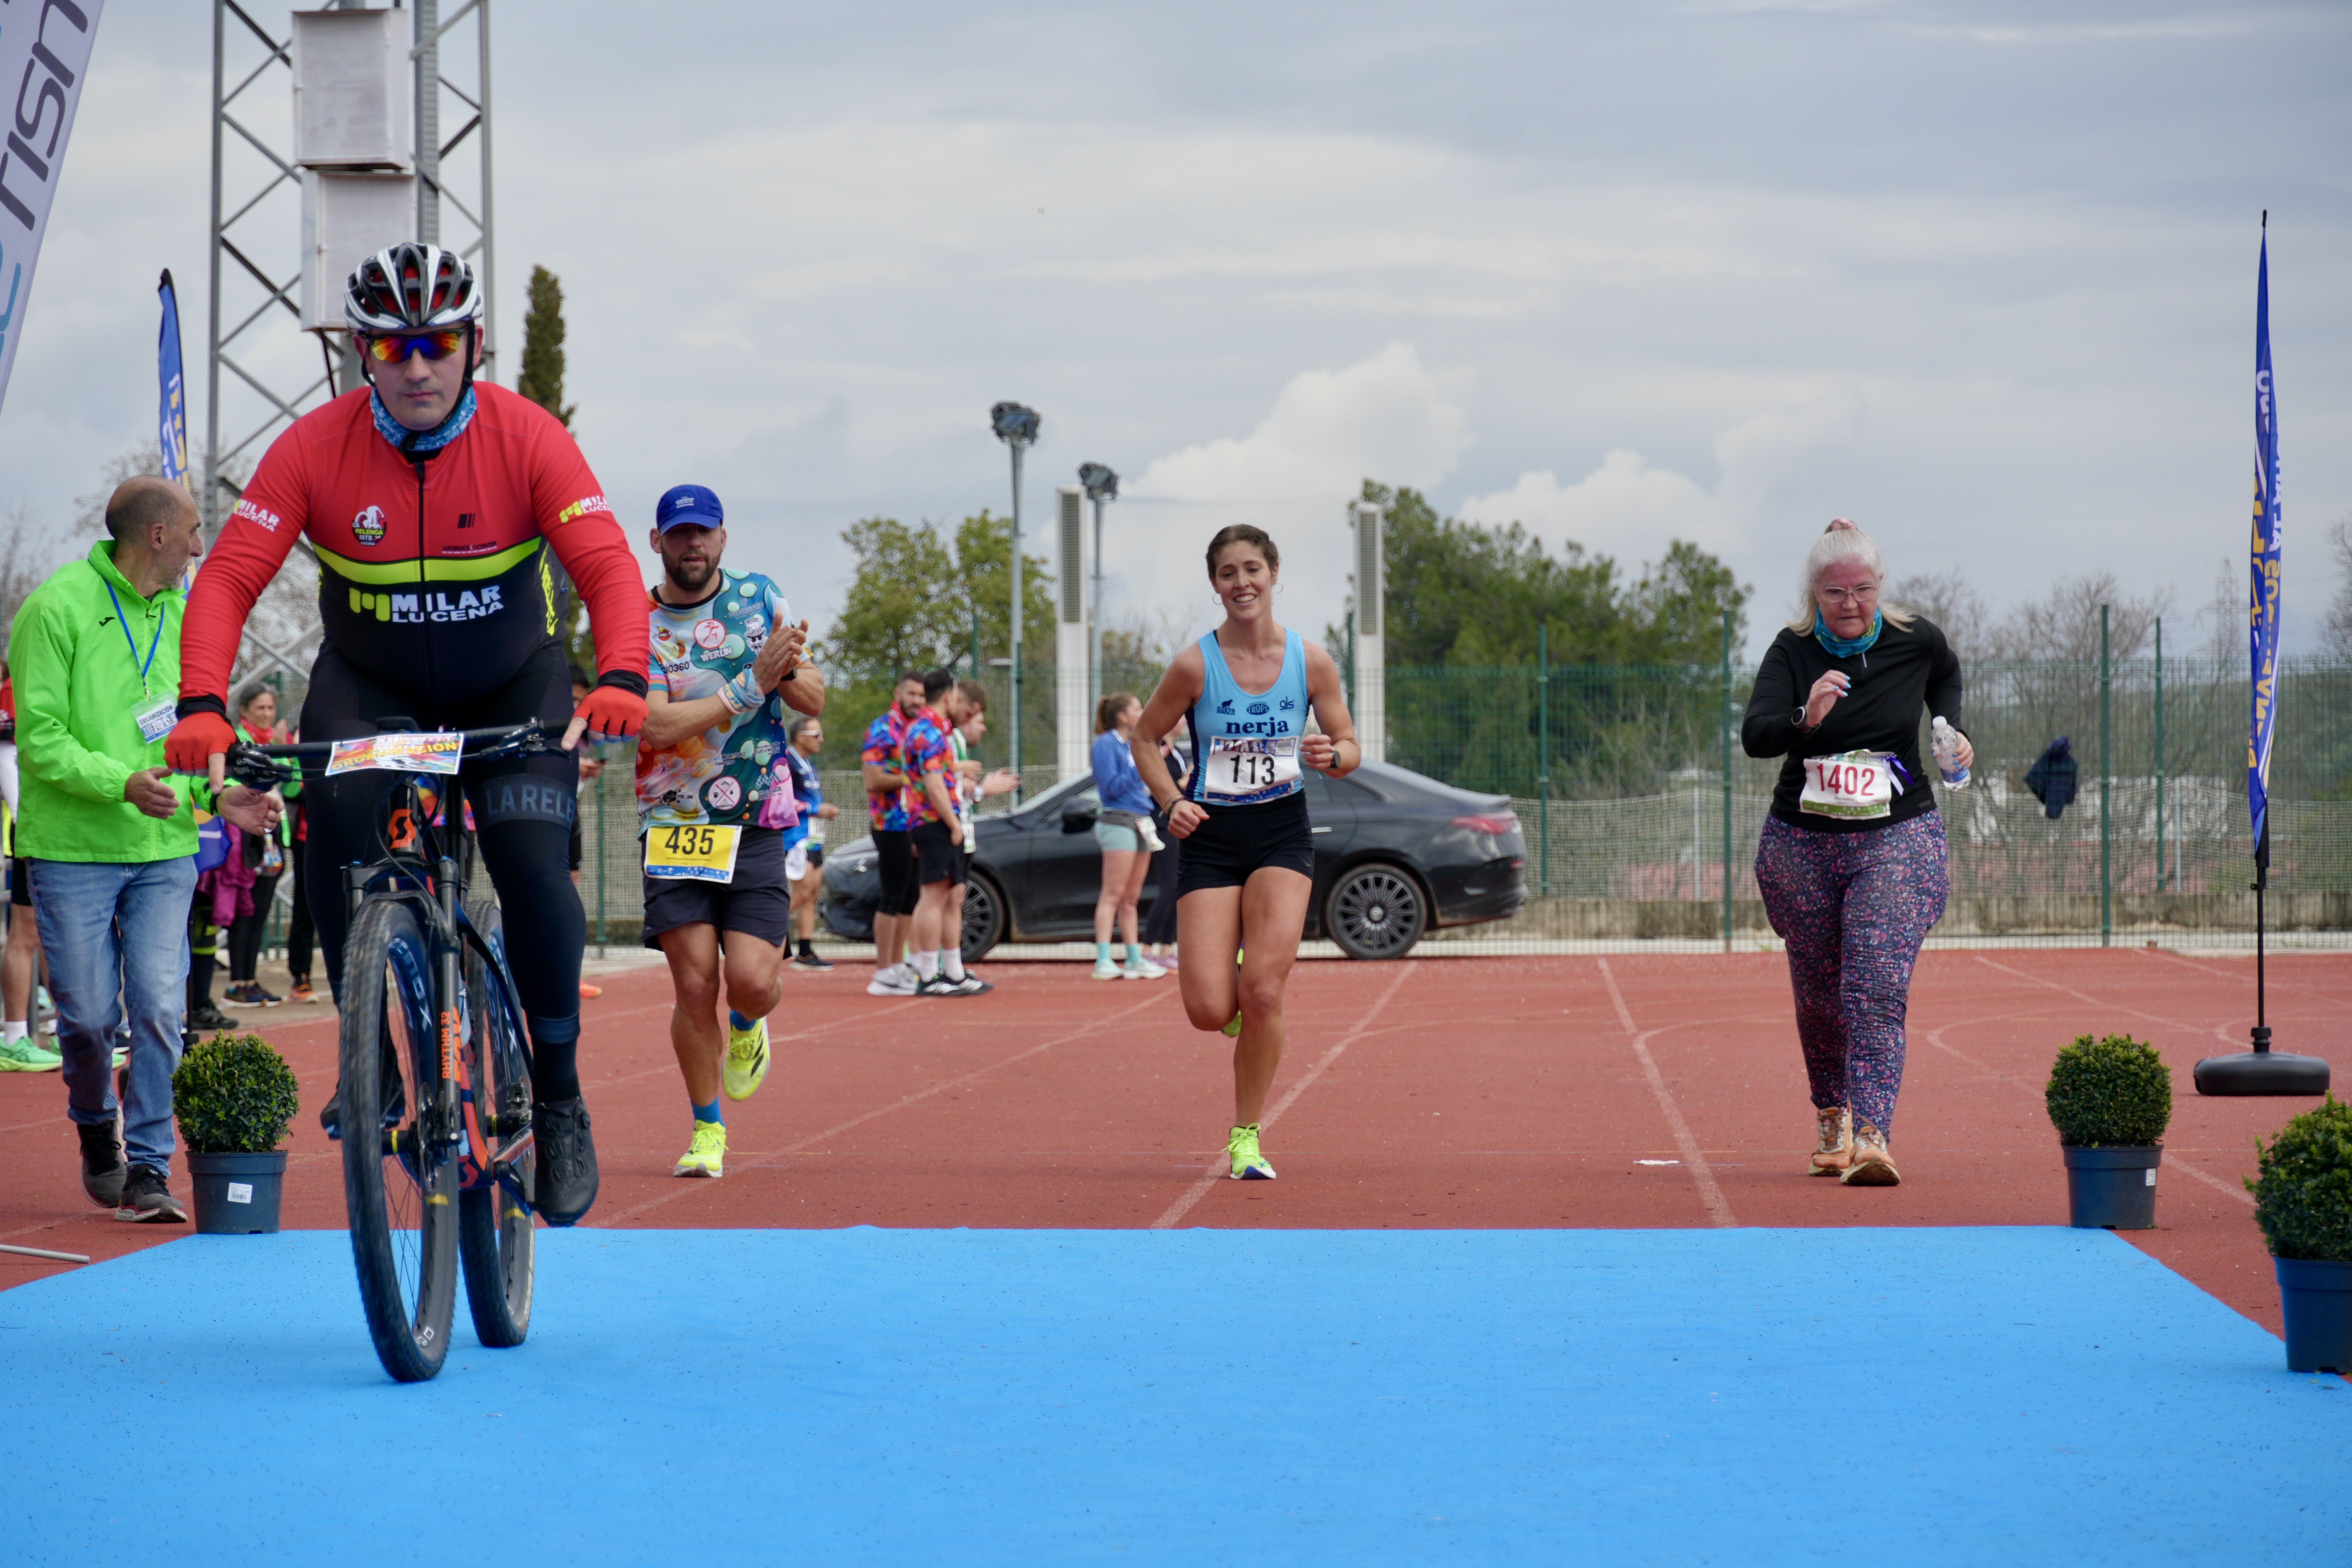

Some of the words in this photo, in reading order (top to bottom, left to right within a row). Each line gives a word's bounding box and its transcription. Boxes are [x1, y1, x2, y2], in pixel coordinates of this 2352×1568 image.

[234, 509, 274, 532] LUCENA
[239, 499, 280, 527] MILAR
[391, 585, 502, 612] MILAR
[392, 601, 504, 623] LUCENA
[700, 646, 733, 662] WERUN
[139, 705, 174, 725] ORGANIZACIÓN
[1248, 704, 1269, 713] TROPS
[1225, 717, 1289, 737] nerja
[332, 741, 457, 770] ORGANIZACIÓN
[1230, 755, 1275, 786] 113
[1817, 763, 1875, 796] 1402
[486, 784, 516, 815] LA
[665, 826, 715, 855] 435
[441, 1012, 450, 1026] 32
[441, 1028, 452, 1079] RHYTHM
